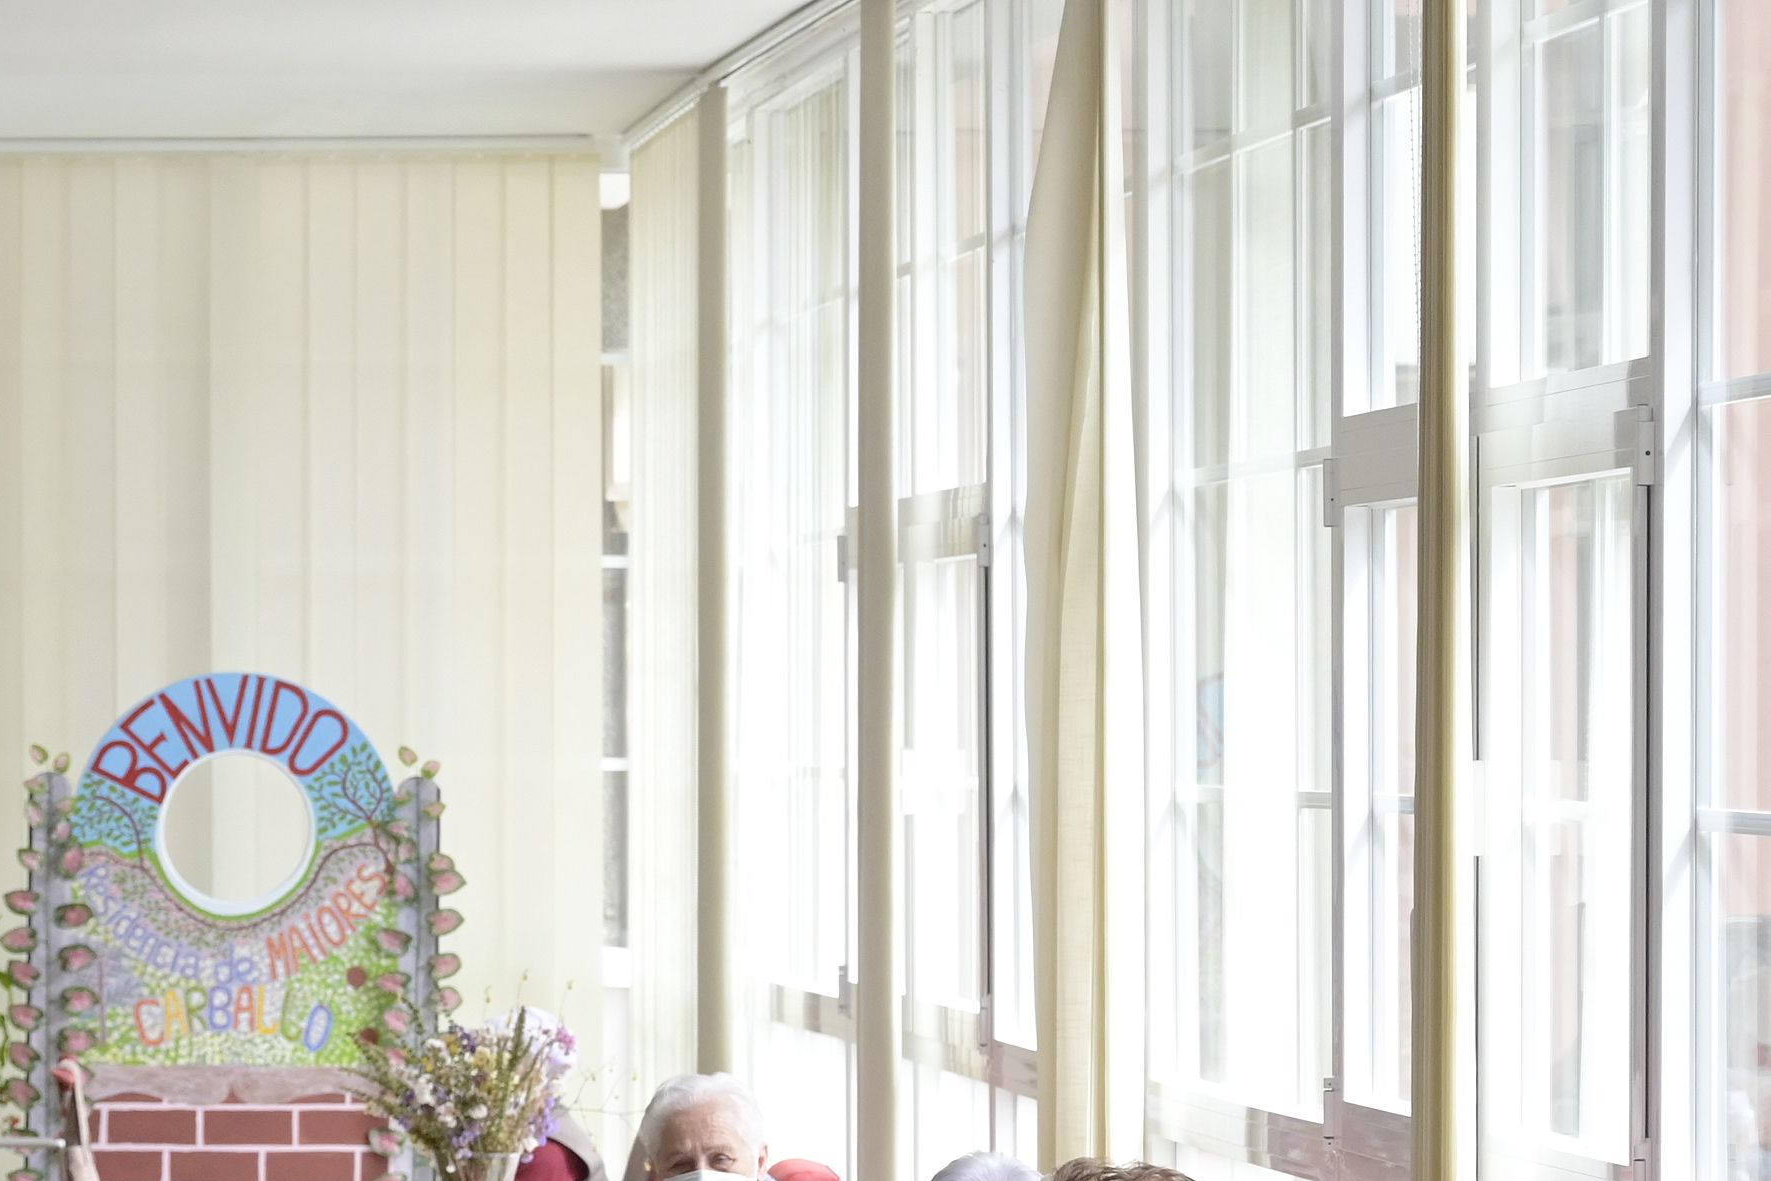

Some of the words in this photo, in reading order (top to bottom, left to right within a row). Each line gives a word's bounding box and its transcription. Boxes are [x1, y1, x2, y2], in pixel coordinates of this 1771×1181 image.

[90, 673, 349, 804] BENVIDO
[79, 863, 202, 982] Residencia
[213, 943, 256, 983] de
[134, 981, 334, 1052] CARBALLO
